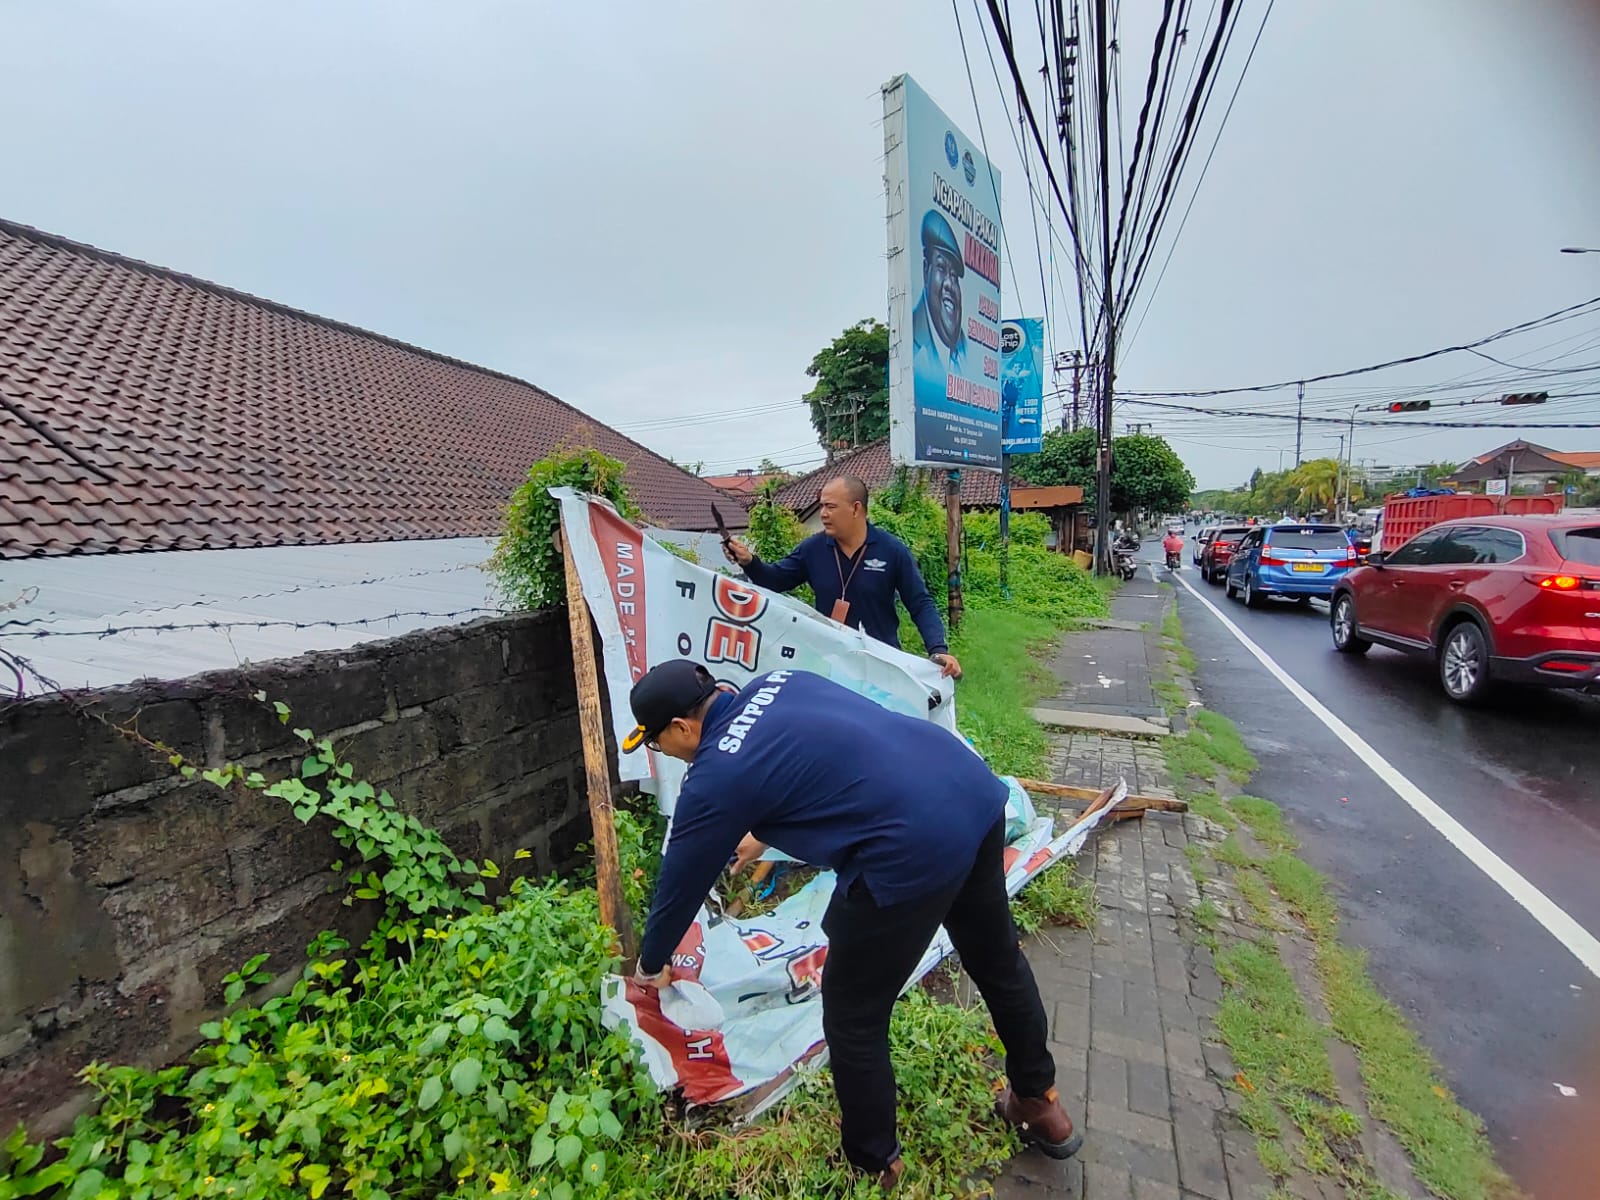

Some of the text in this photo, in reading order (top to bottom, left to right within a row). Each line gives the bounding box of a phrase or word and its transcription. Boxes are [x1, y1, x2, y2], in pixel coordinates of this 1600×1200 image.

[933, 171, 998, 251] NGAPAIN PAKAI
[616, 542, 635, 615] MADE
[718, 686, 781, 753] SATPOL
[765, 670, 793, 683] P
